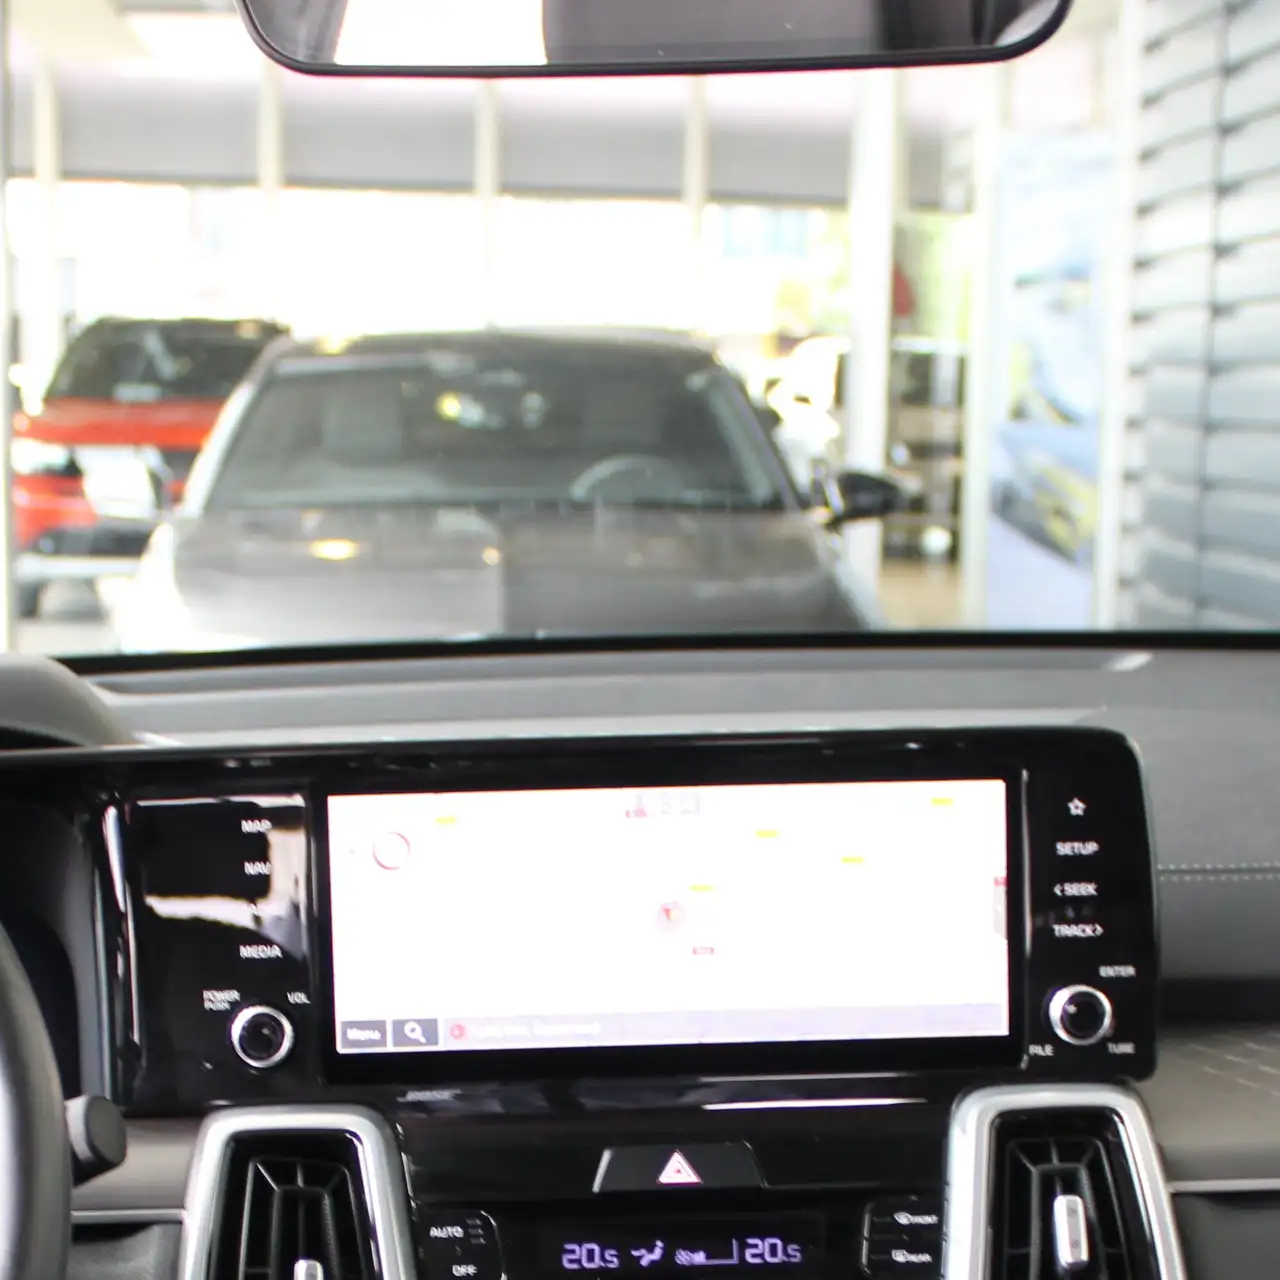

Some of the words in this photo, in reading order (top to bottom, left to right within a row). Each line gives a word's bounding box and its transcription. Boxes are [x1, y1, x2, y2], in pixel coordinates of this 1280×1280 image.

[241, 820, 272, 833] MAP
[1056, 841, 1099, 856] SETUP
[244, 862, 271, 875] NAV
[239, 945, 283, 959] MEDIA
[286, 992, 311, 1004] VOL
[429, 1225, 464, 1238] AUTO
